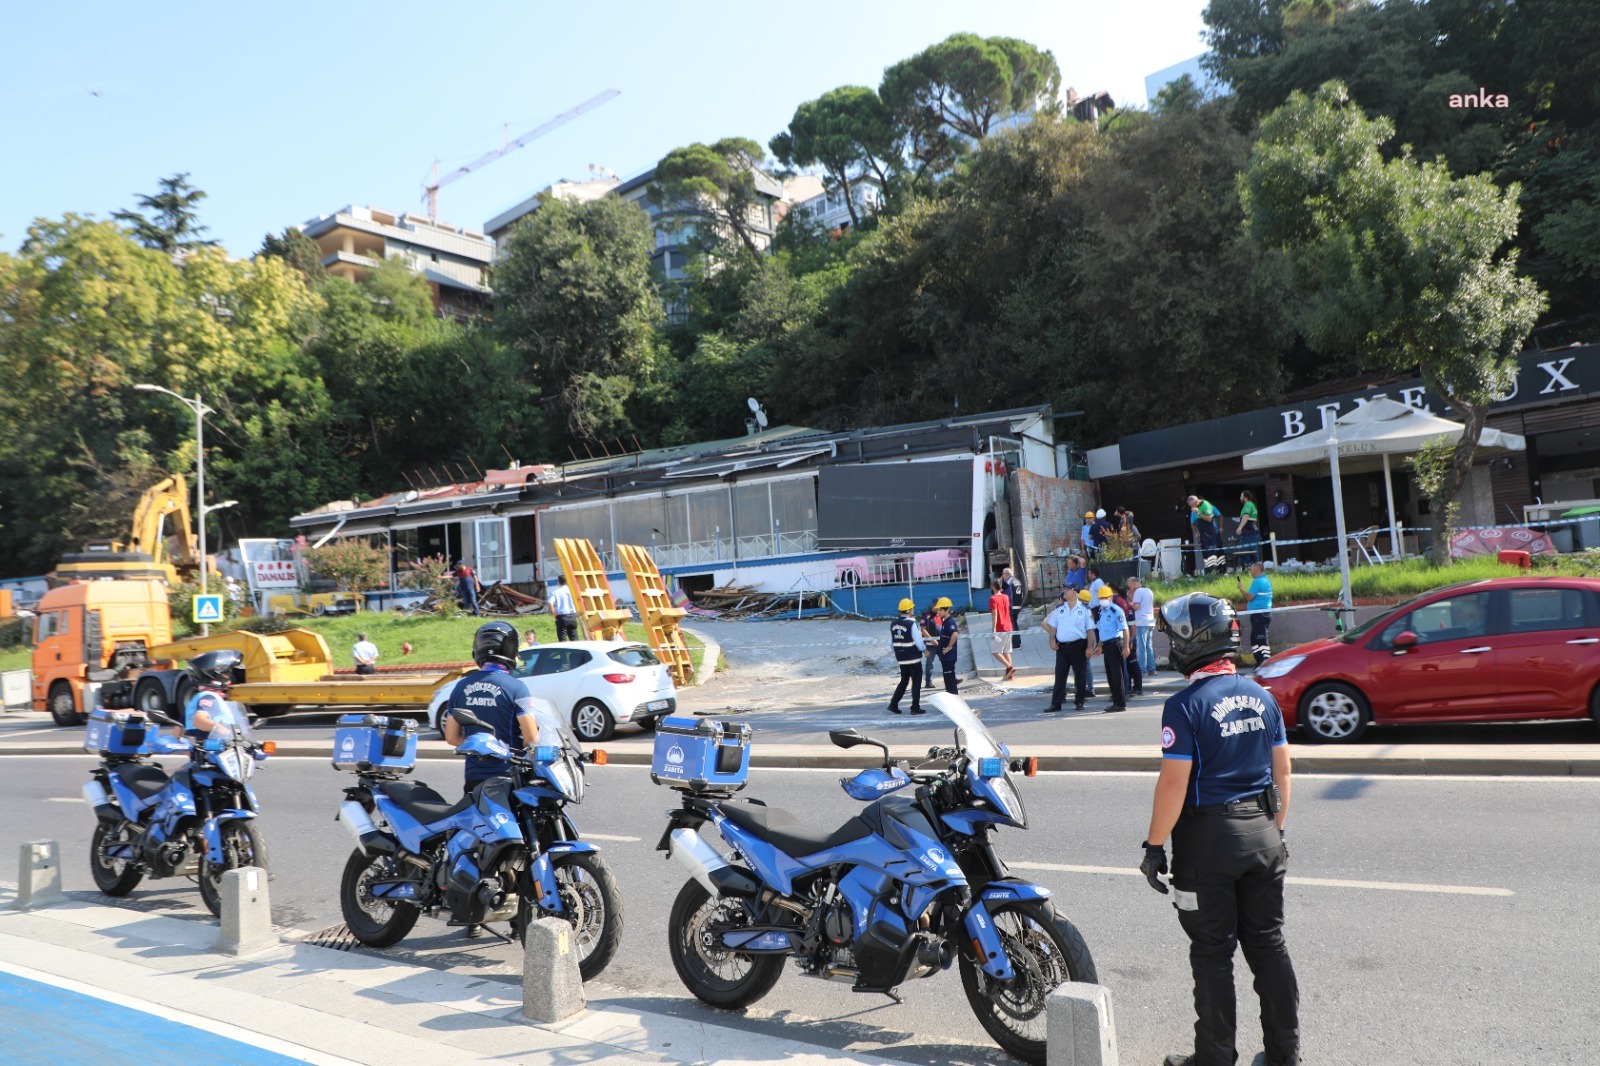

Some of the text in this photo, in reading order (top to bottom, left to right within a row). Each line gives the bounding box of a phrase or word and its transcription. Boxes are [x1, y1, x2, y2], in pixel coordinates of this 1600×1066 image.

[465, 696, 497, 707] ZABITA
[1219, 716, 1266, 738] ZABITA
[663, 765, 684, 775] ZABITA
